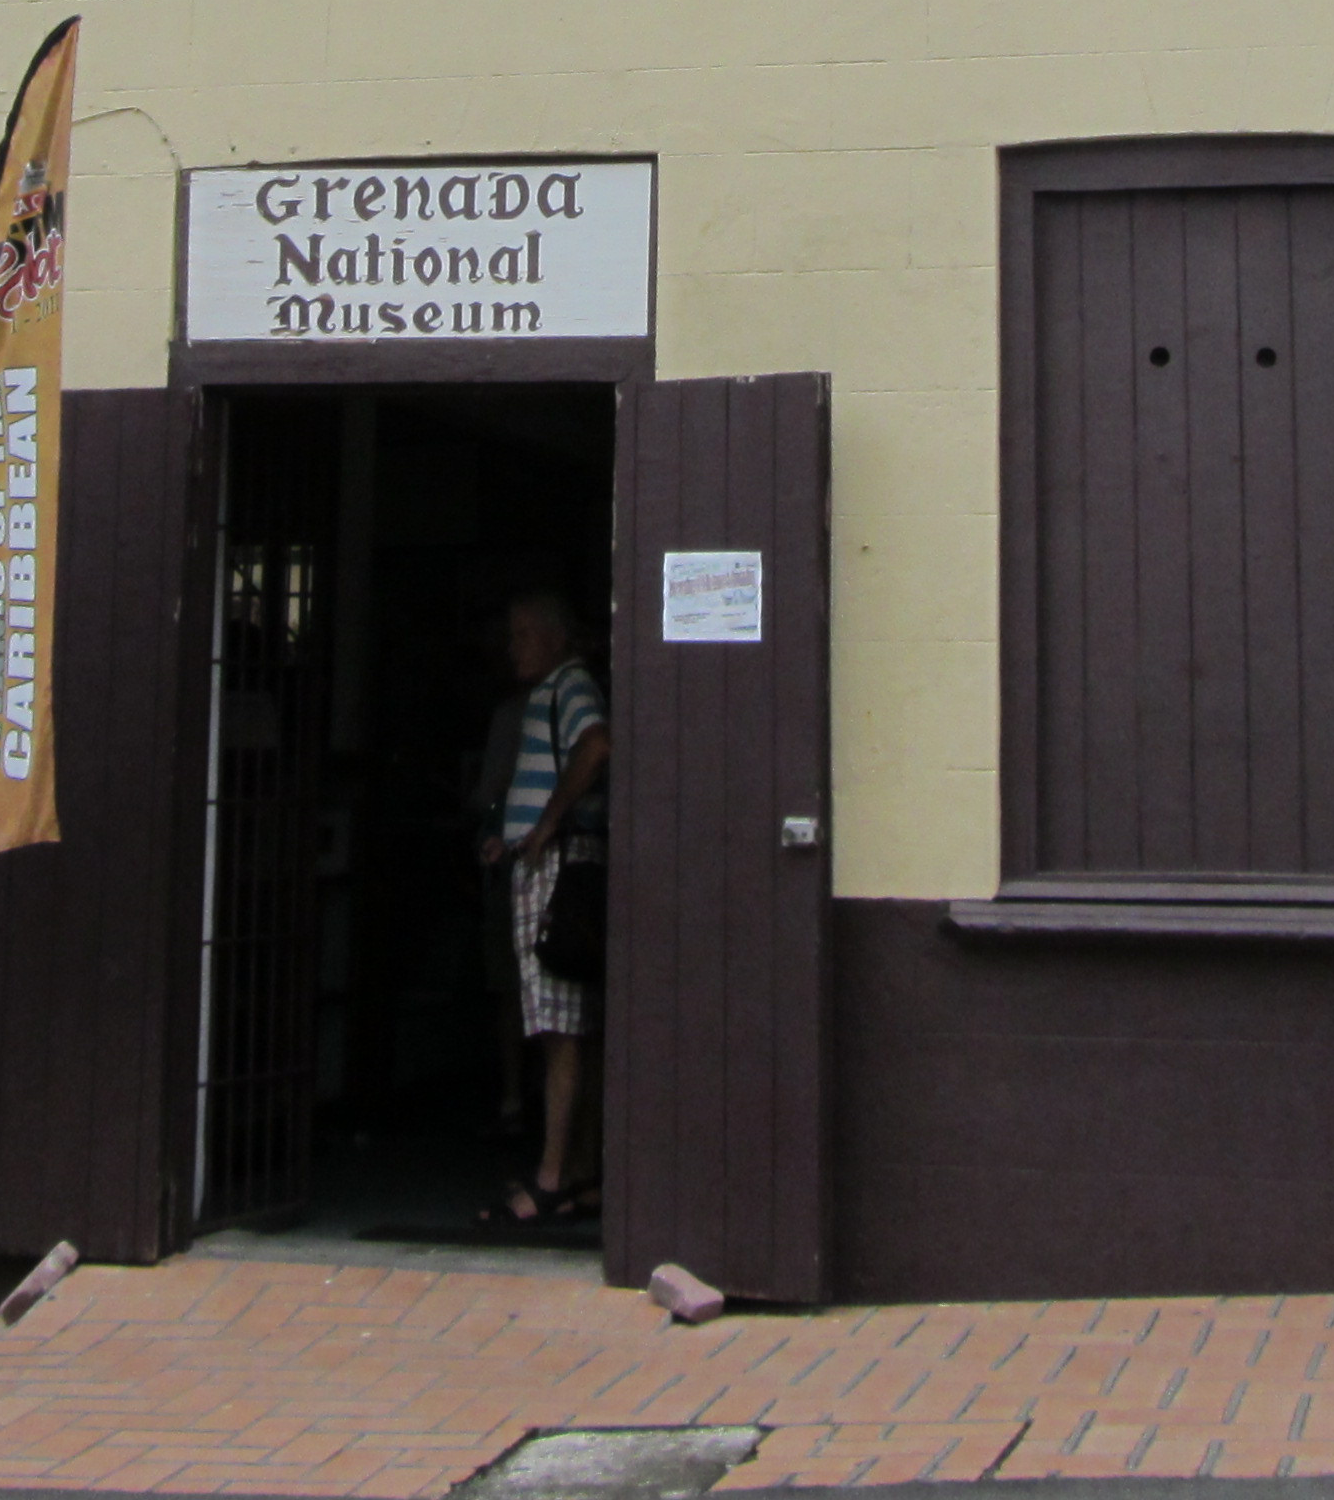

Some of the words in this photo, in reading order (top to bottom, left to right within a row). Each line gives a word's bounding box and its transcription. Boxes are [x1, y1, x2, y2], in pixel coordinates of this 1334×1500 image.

[273, 229, 545, 286] National
[266, 293, 543, 335] Museum
[3, 366, 38, 781] CARIBBEAN
